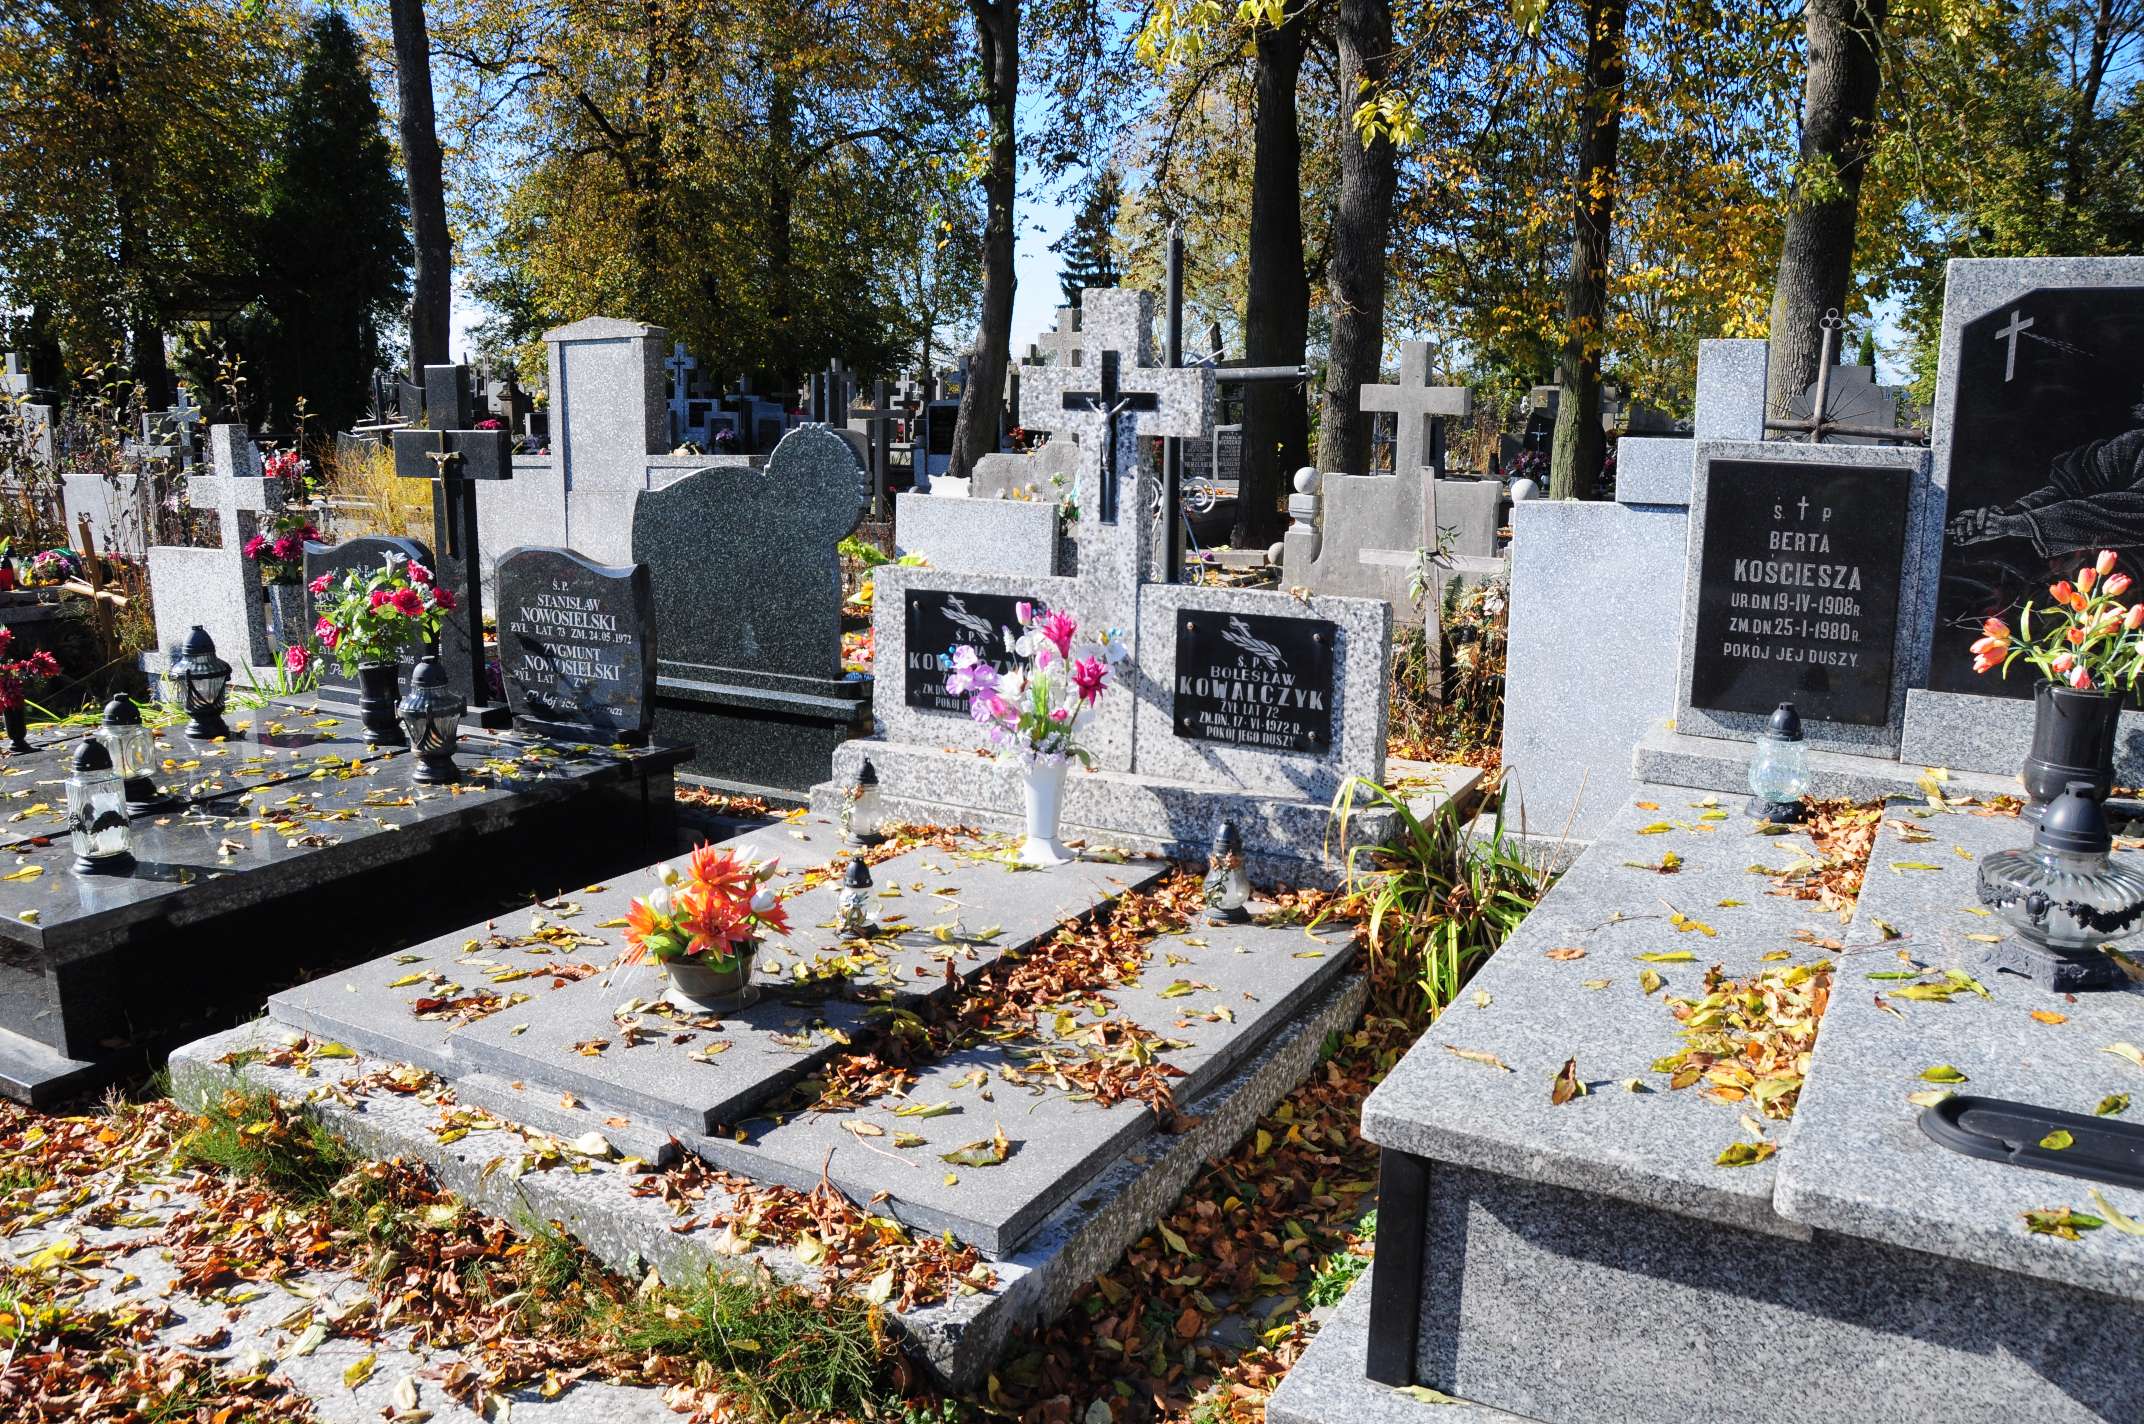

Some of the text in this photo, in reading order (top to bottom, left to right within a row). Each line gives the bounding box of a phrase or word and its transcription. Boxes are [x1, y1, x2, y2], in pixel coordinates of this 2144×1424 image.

[1769, 530, 1830, 553] BERTA
[1734, 553, 1861, 591] KOŚCIESZA
[520, 607, 617, 631] NOWOSIELSKI
[535, 625, 553, 636] LAT
[557, 627, 566, 638] 73
[1775, 647, 1804, 661] JEJ
[537, 673, 554, 684] LAT
[1210, 665, 1296, 687] BOLESŁAW
[1179, 675, 1324, 711] KOWALCZYK
[1243, 703, 1260, 716] LAT
[1266, 706, 1279, 719] 72
[1238, 729, 1260, 744] JEGO
[1262, 732, 1296, 748] DUSZY
